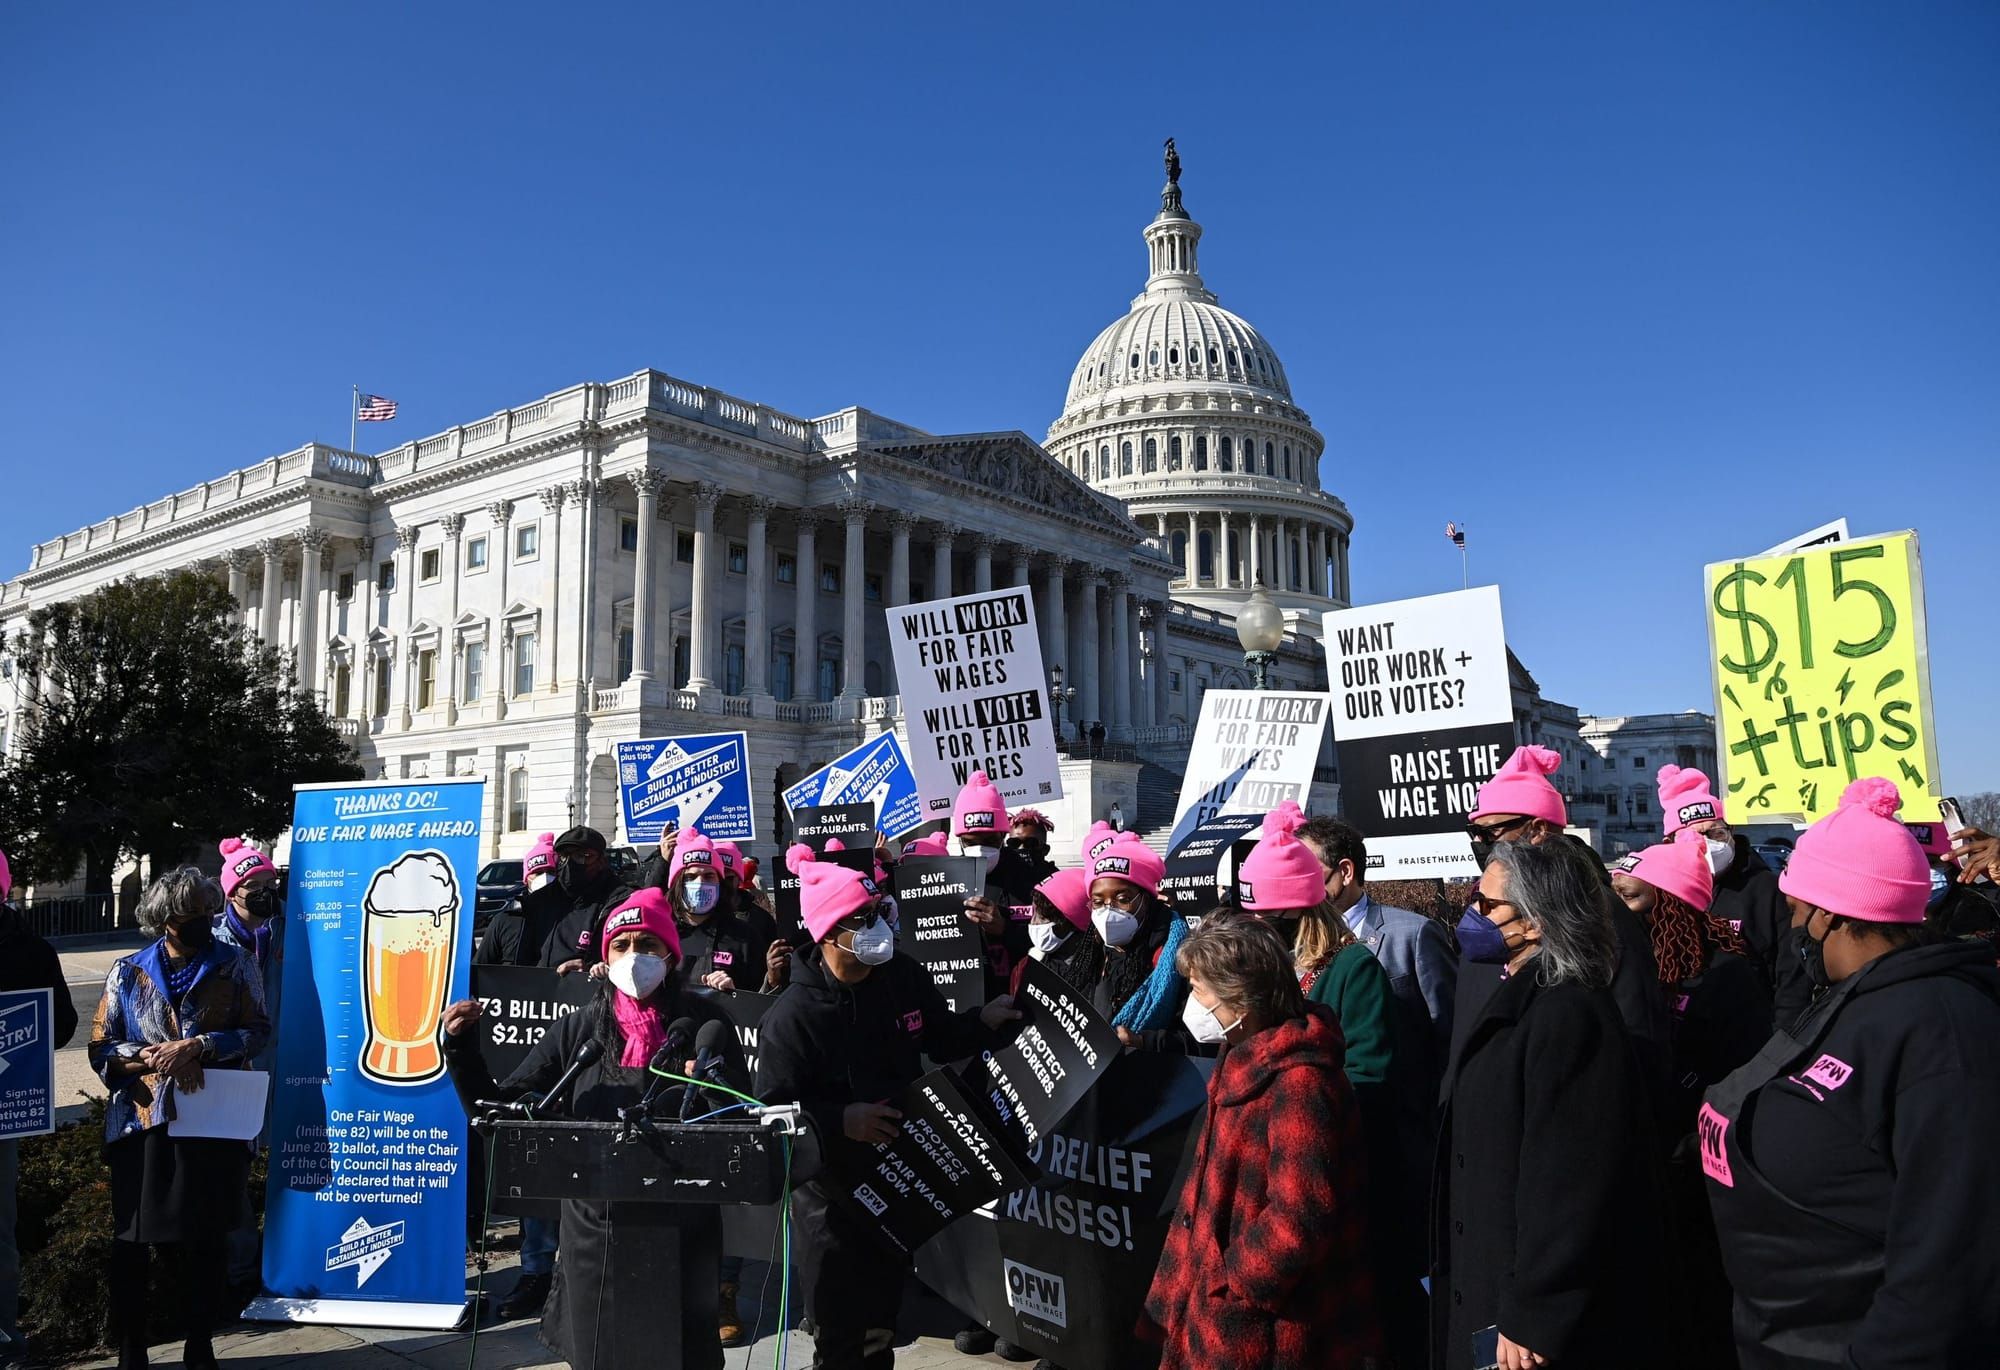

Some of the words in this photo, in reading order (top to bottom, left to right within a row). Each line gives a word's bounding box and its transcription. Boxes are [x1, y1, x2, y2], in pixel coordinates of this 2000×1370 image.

[901, 609, 954, 640] WILL
[959, 597, 1023, 632] WORK
[1713, 545, 1897, 684] $15
[919, 638, 958, 667] FOR
[966, 628, 1015, 659] FAIR
[1337, 621, 1395, 656] WANT
[934, 659, 1007, 694] WAGES
[1341, 658, 1380, 688] OUR
[1388, 647, 1448, 682] WORK
[1455, 650, 1472, 667] +
[1212, 698, 1252, 720] WILL
[1261, 699, 1318, 722] WORK
[1345, 690, 1384, 720] OUR
[1390, 679, 1465, 715] VOTES?
[923, 703, 975, 734] WILL
[979, 693, 1035, 724] VOTE
[935, 732, 975, 761] FOR
[982, 723, 1031, 753] FAIR
[1215, 722, 1249, 745] FOR
[1255, 724, 1299, 747] FAIR
[620, 744, 634, 753] Fair
[635, 744, 655, 752] wage
[620, 753, 636, 762] plus
[637, 752, 654, 761] tips.
[665, 746, 678, 759] DC
[1220, 747, 1283, 771] WAGES
[652, 753, 684, 772] COMMITTEE
[1390, 748, 1452, 784] RAISE
[1455, 744, 1500, 779] THE
[633, 779, 689, 813] RESTAURANT
[691, 757, 736, 787] INDUSTRY
[647, 774, 673, 795] BUILD
[675, 771, 682, 782] A
[684, 754, 719, 778] BETTER
[829, 770, 841, 785] DC
[850, 759, 880, 790] BETTER
[859, 755, 895, 797] INDUSTRY
[787, 791, 801, 800] Fair
[801, 779, 820, 793] wage
[791, 796, 805, 810] plus
[805, 787, 820, 800] tips.
[334, 793, 401, 816] THANKS
[405, 791, 438, 807] DC!
[721, 806, 736, 814] Sign
[895, 797, 908, 808] Sign
[1378, 785, 1442, 819] WAGE
[1679, 803, 1711, 819] OFW
[704, 813, 729, 822] petition
[737, 813, 748, 821] put
[821, 813, 847, 824] SAVE
[882, 804, 904, 822] petition
[882, 808, 915, 830] Initiative
[965, 813, 992, 824] OFW
[295, 826, 328, 843] ONE
[331, 825, 366, 841] FAIR
[370, 823, 416, 840] WAGE
[418, 820, 479, 838] AHEAD.
[702, 821, 737, 830] Initiative
[798, 823, 870, 836] RESTAURANTS.
[1178, 848, 1215, 858] WORKERS.
[1187, 839, 1224, 848] PROTECT
[236, 856, 259, 873] OFW
[684, 851, 710, 861] OFW
[1096, 858, 1128, 869] OFW
[300, 879, 344, 889] signatures
[305, 869, 344, 879] Collected
[920, 872, 946, 885] SAVE
[1160, 878, 1173, 889] ONE
[1174, 876, 1191, 888] FAIR
[1192, 875, 1215, 886] WAGE
[901, 883, 969, 900] RESTAURANTS.
[1176, 890, 1198, 900] NOW.
[297, 912, 341, 922] signatures
[315, 902, 342, 911] 26,205
[323, 921, 341, 931] goal
[917, 915, 958, 928] PROTECT
[915, 928, 963, 941] WORKERS.
[926, 961, 948, 972] FAIR
[950, 958, 980, 970] WAGE
[1058, 994, 1089, 1030] SAVE
[491, 1022, 545, 1045] $2.13
[1026, 983, 1098, 1069] RESTAURANTS.
[1026, 1025, 1066, 1080] PROTECT
[1014, 1033, 1055, 1098] WORKERS.
[1814, 1059, 1846, 1081] OFW
[5, 1090, 27, 1100] Sign
[29, 1087, 45, 1096] the
[17, 1099, 27, 1107] to
[28, 1097, 45, 1107] put
[982, 1050, 1002, 1078] ONE
[997, 1074, 1019, 1104] FAIR
[1014, 1102, 1038, 1143] WAGE
[29, 1107, 45, 1117] 82
[331, 1110, 354, 1122] One
[357, 1110, 380, 1122] Fair
[383, 1110, 415, 1125] Wage
[990, 1089, 1012, 1126] NOW.
[15, 1118, 45, 1129] ballot.
[296, 1125, 347, 1138] (Initiative
[350, 1126, 370, 1140] 82)
[373, 1126, 393, 1138] will
[396, 1127, 410, 1138] be
[412, 1129, 427, 1139] on
[430, 1128, 448, 1140] the
[957, 1113, 990, 1150] SAVE
[922, 1086, 1002, 1186] RESTAURANTS.
[281, 1142, 311, 1153] June
[313, 1142, 339, 1154] 2022
[342, 1142, 379, 1155] ballot,
[382, 1143, 404, 1155] and
[407, 1143, 425, 1155] the
[428, 1144, 459, 1156] Chair
[902, 1120, 960, 1186] WORKERS.
[916, 1118, 970, 1176] PROTECT
[281, 1157, 296, 1169] of
[298, 1157, 317, 1169] the
[319, 1158, 341, 1172] City
[343, 1158, 389, 1171] Council
[392, 1159, 412, 1171] has
[414, 1160, 457, 1175] already
[1050, 1134, 1151, 1192] RELIEF
[290, 1173, 335, 1188] publicly
[337, 1174, 389, 1187] declared
[392, 1175, 415, 1187] that
[417, 1176, 425, 1188] it
[429, 1176, 449, 1188] will
[876, 1162, 911, 1198] NOW.
[885, 1152, 915, 1181] FAIR
[914, 1179, 953, 1219] WAGE
[315, 1190, 333, 1202] not
[335, 1190, 350, 1202] be
[353, 1191, 423, 1204] overturned!
[858, 1185, 887, 1211] OFW
[1007, 1186, 1134, 1251] RAISES!
[328, 1246, 368, 1267] RESTAURANT
[370, 1233, 403, 1253] INDUSTRY
[339, 1240, 359, 1254] BUILD
[366, 1229, 392, 1245] BETTER
[1008, 1266, 1060, 1308] OFW
[1025, 1300, 1040, 1310] FAIR
[1043, 1306, 1063, 1319] WAGE
